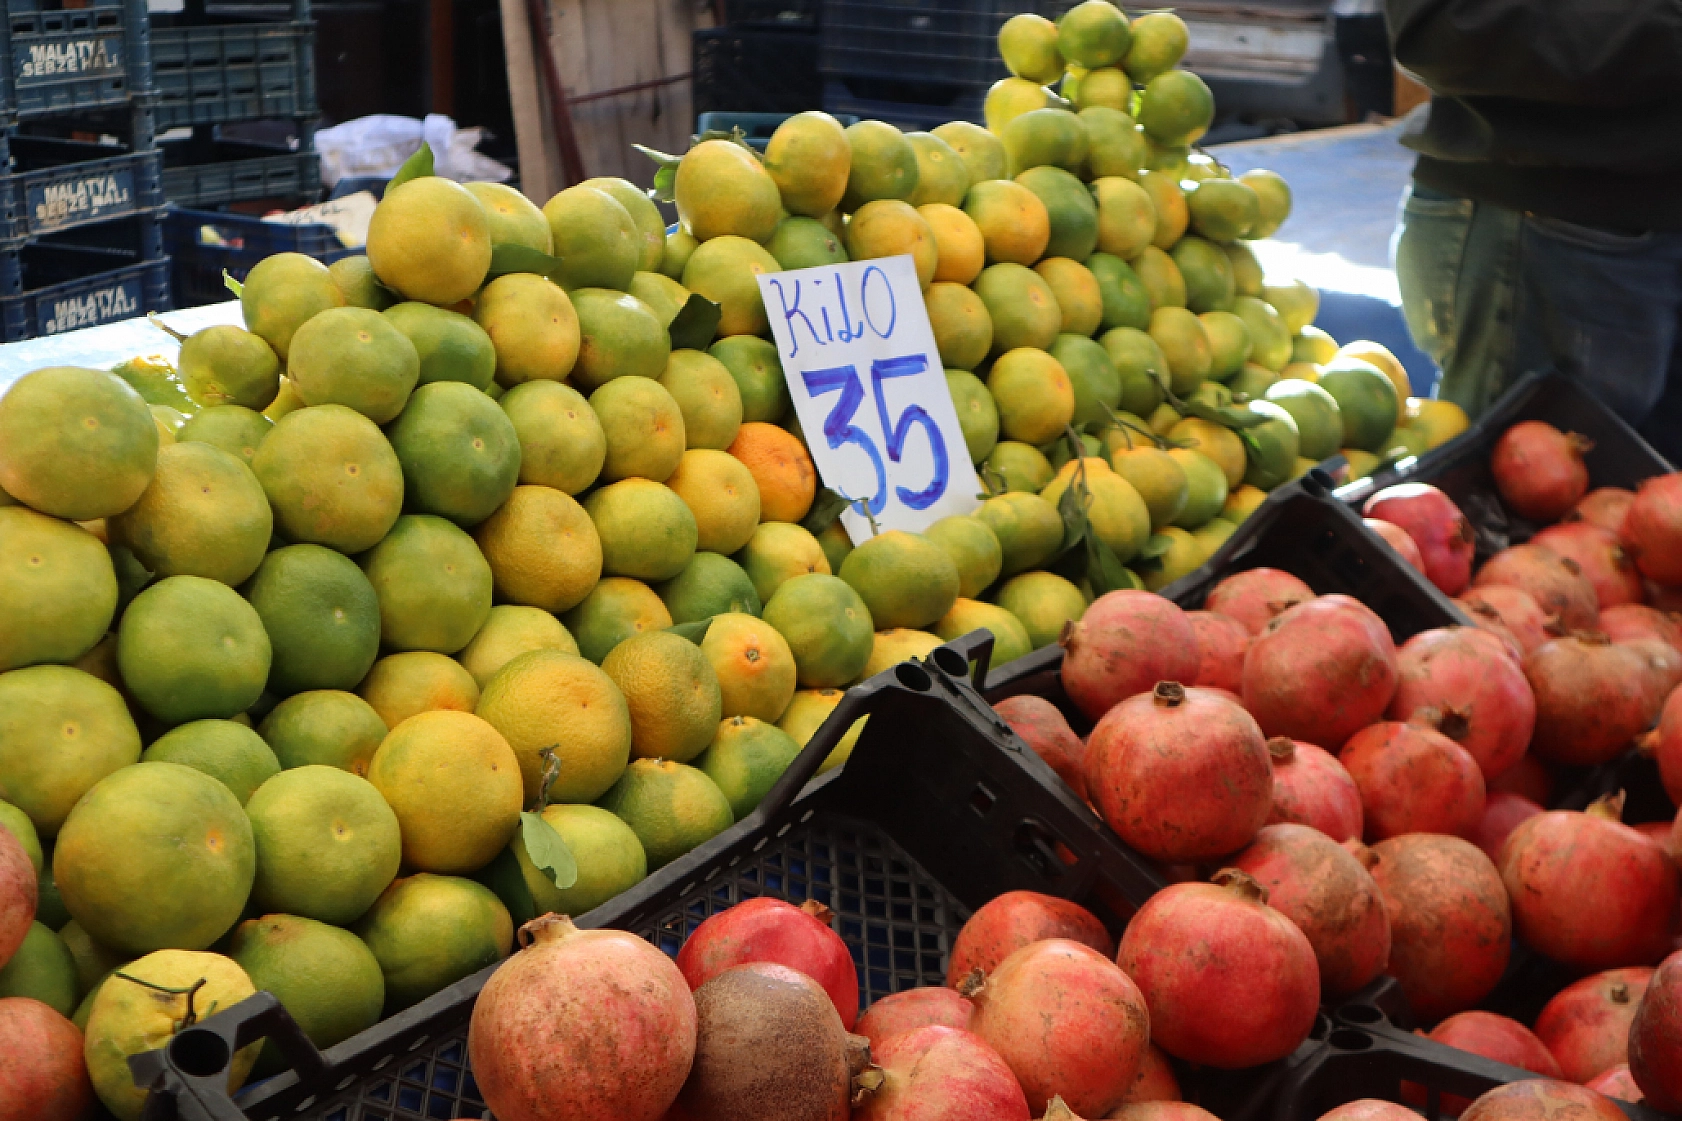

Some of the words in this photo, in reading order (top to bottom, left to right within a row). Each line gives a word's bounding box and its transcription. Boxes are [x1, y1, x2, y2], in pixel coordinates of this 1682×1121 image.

[29, 40, 106, 63] MALATYA
[44, 175, 118, 207] MALATYA
[54, 286, 126, 318] MALATYA
[801, 353, 949, 517] 35
